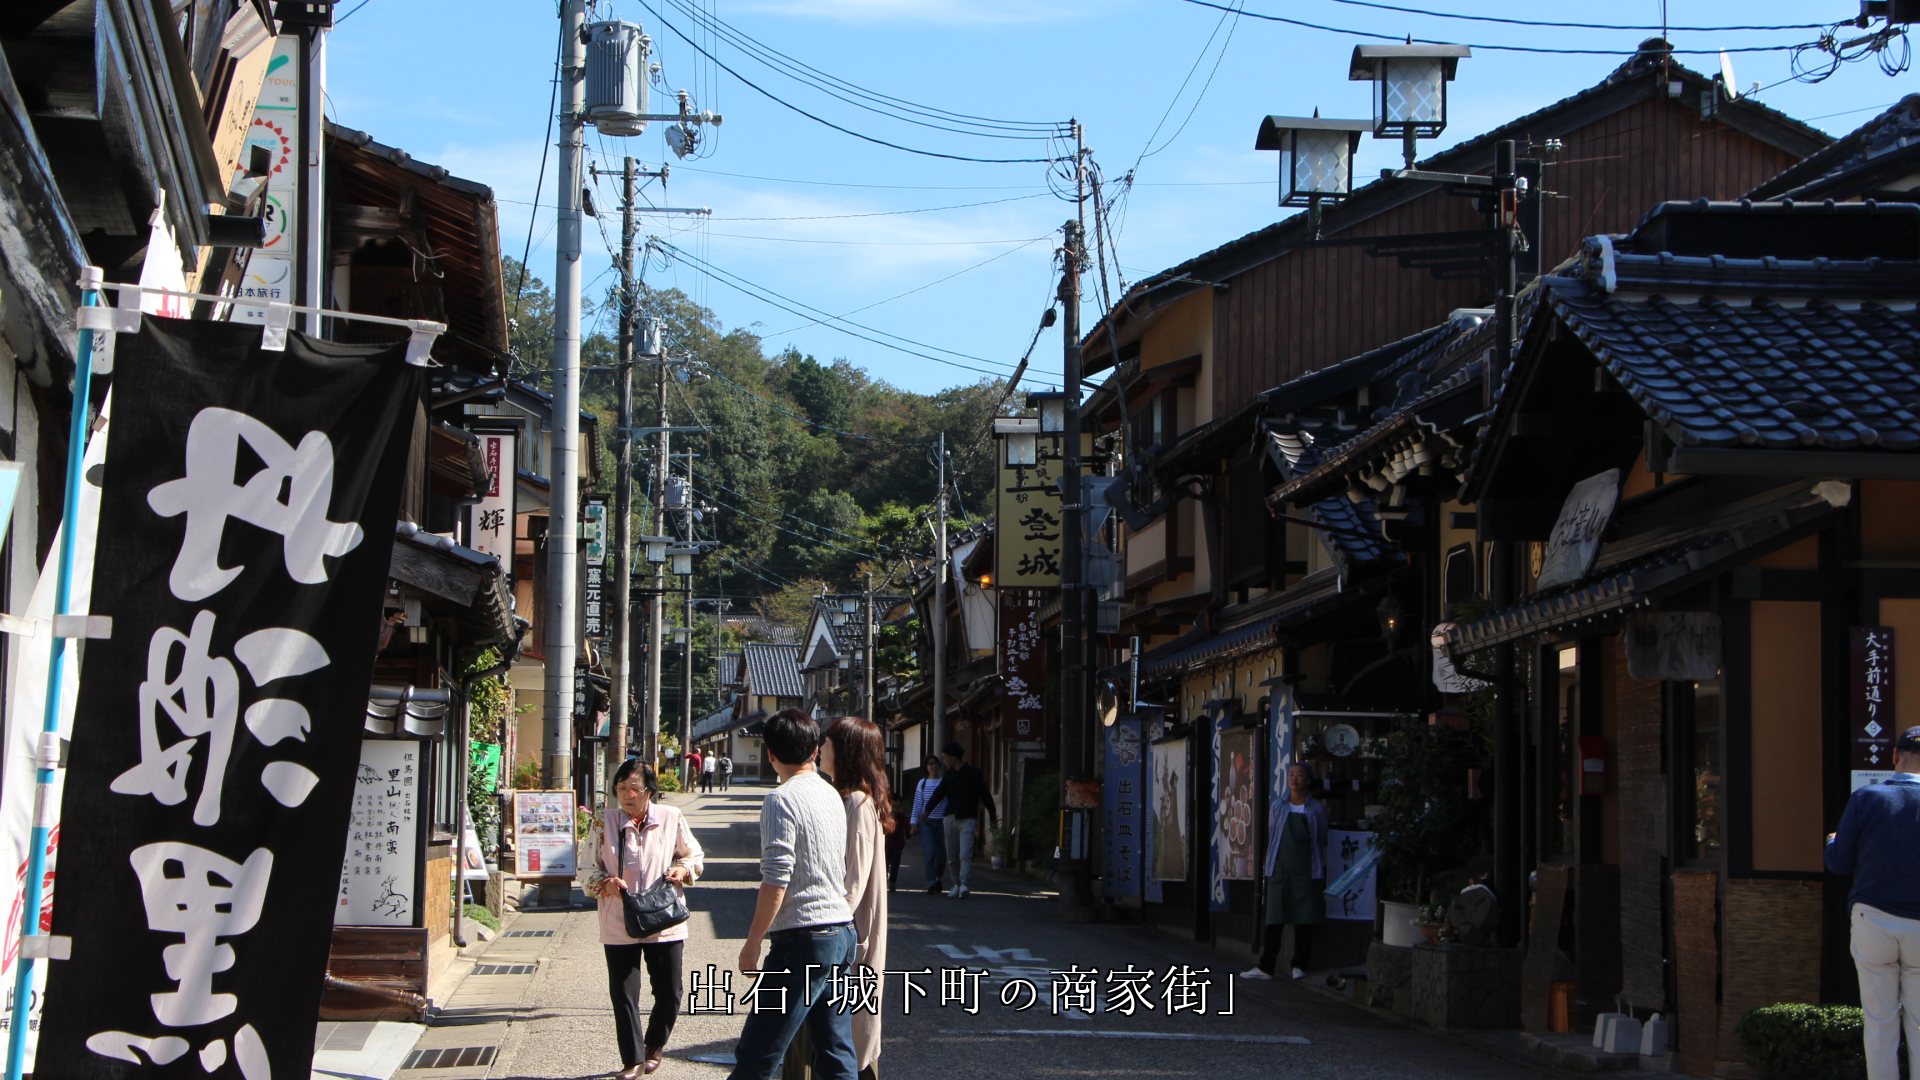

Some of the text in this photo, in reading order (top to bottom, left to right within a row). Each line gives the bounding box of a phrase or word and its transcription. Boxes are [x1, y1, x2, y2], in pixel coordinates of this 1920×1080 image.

[1016, 507, 1060, 576] 登城
[586, 567, 602, 634] 窯元直売
[1004, 676, 1043, 710] 登城
[1864, 631, 1883, 718] 大手前通り
[1869, 723, 1877, 734] 9
[1116, 778, 1133, 883] 出石皿そば
